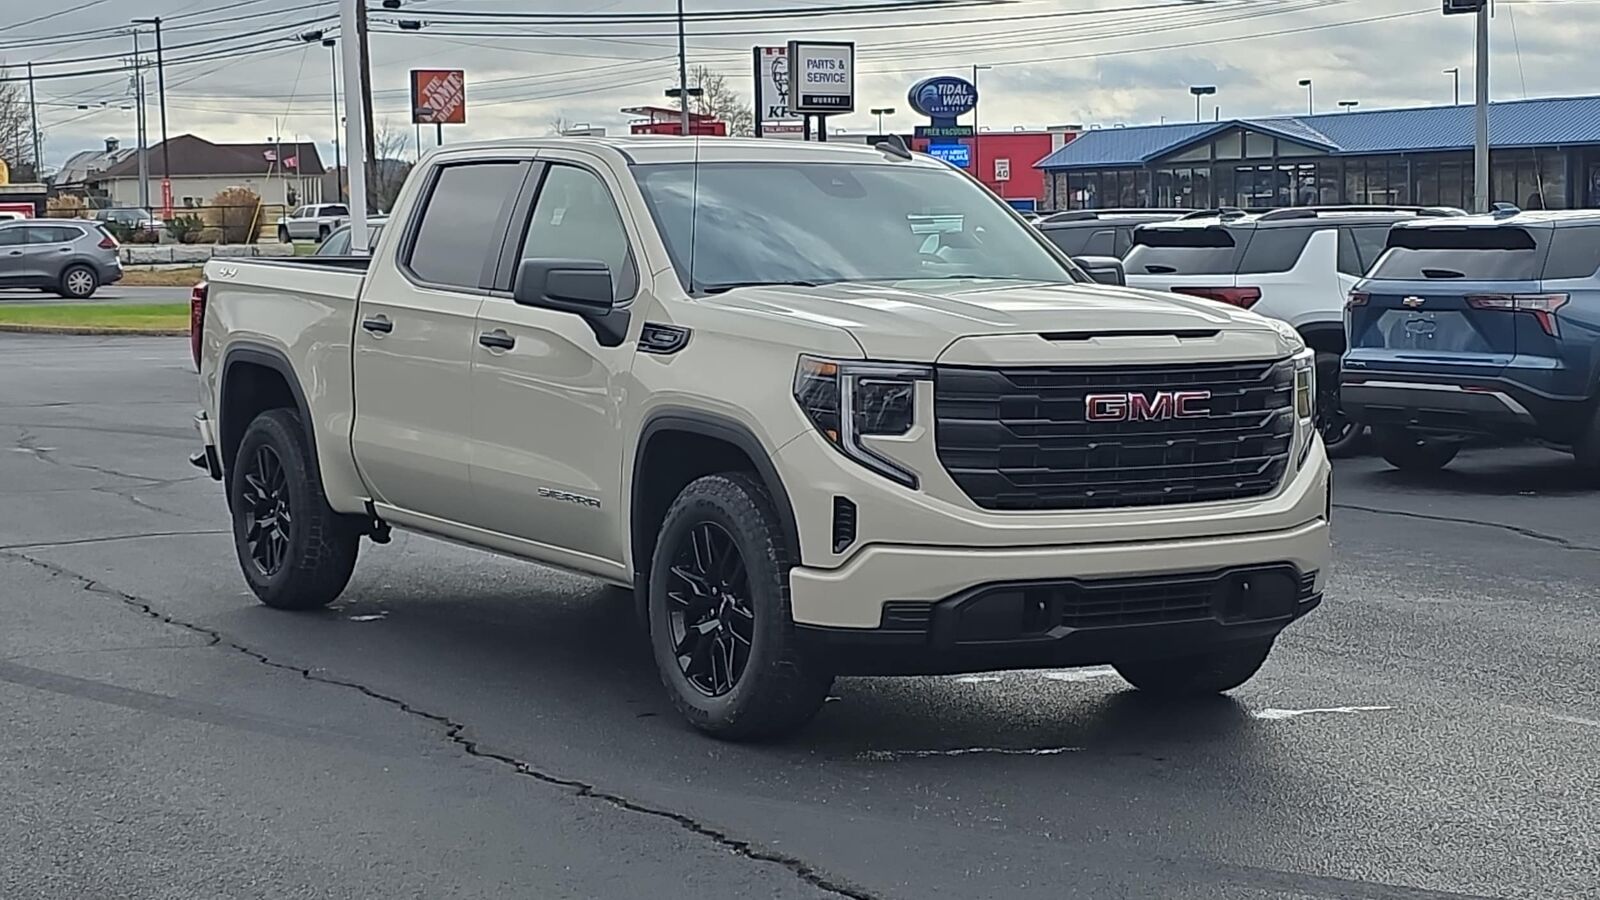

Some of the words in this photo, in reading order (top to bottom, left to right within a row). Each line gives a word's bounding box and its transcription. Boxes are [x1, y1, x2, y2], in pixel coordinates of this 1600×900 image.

[807, 59, 835, 69] PARTS
[838, 60, 845, 69] &
[807, 73, 846, 83] SERVICE
[422, 75, 441, 97] THE
[937, 84, 968, 95] TIDAL
[943, 95, 974, 106] WAVE
[996, 170, 1009, 178] 40
[1086, 391, 1211, 421] GMC
[537, 487, 601, 509] SIERRA
